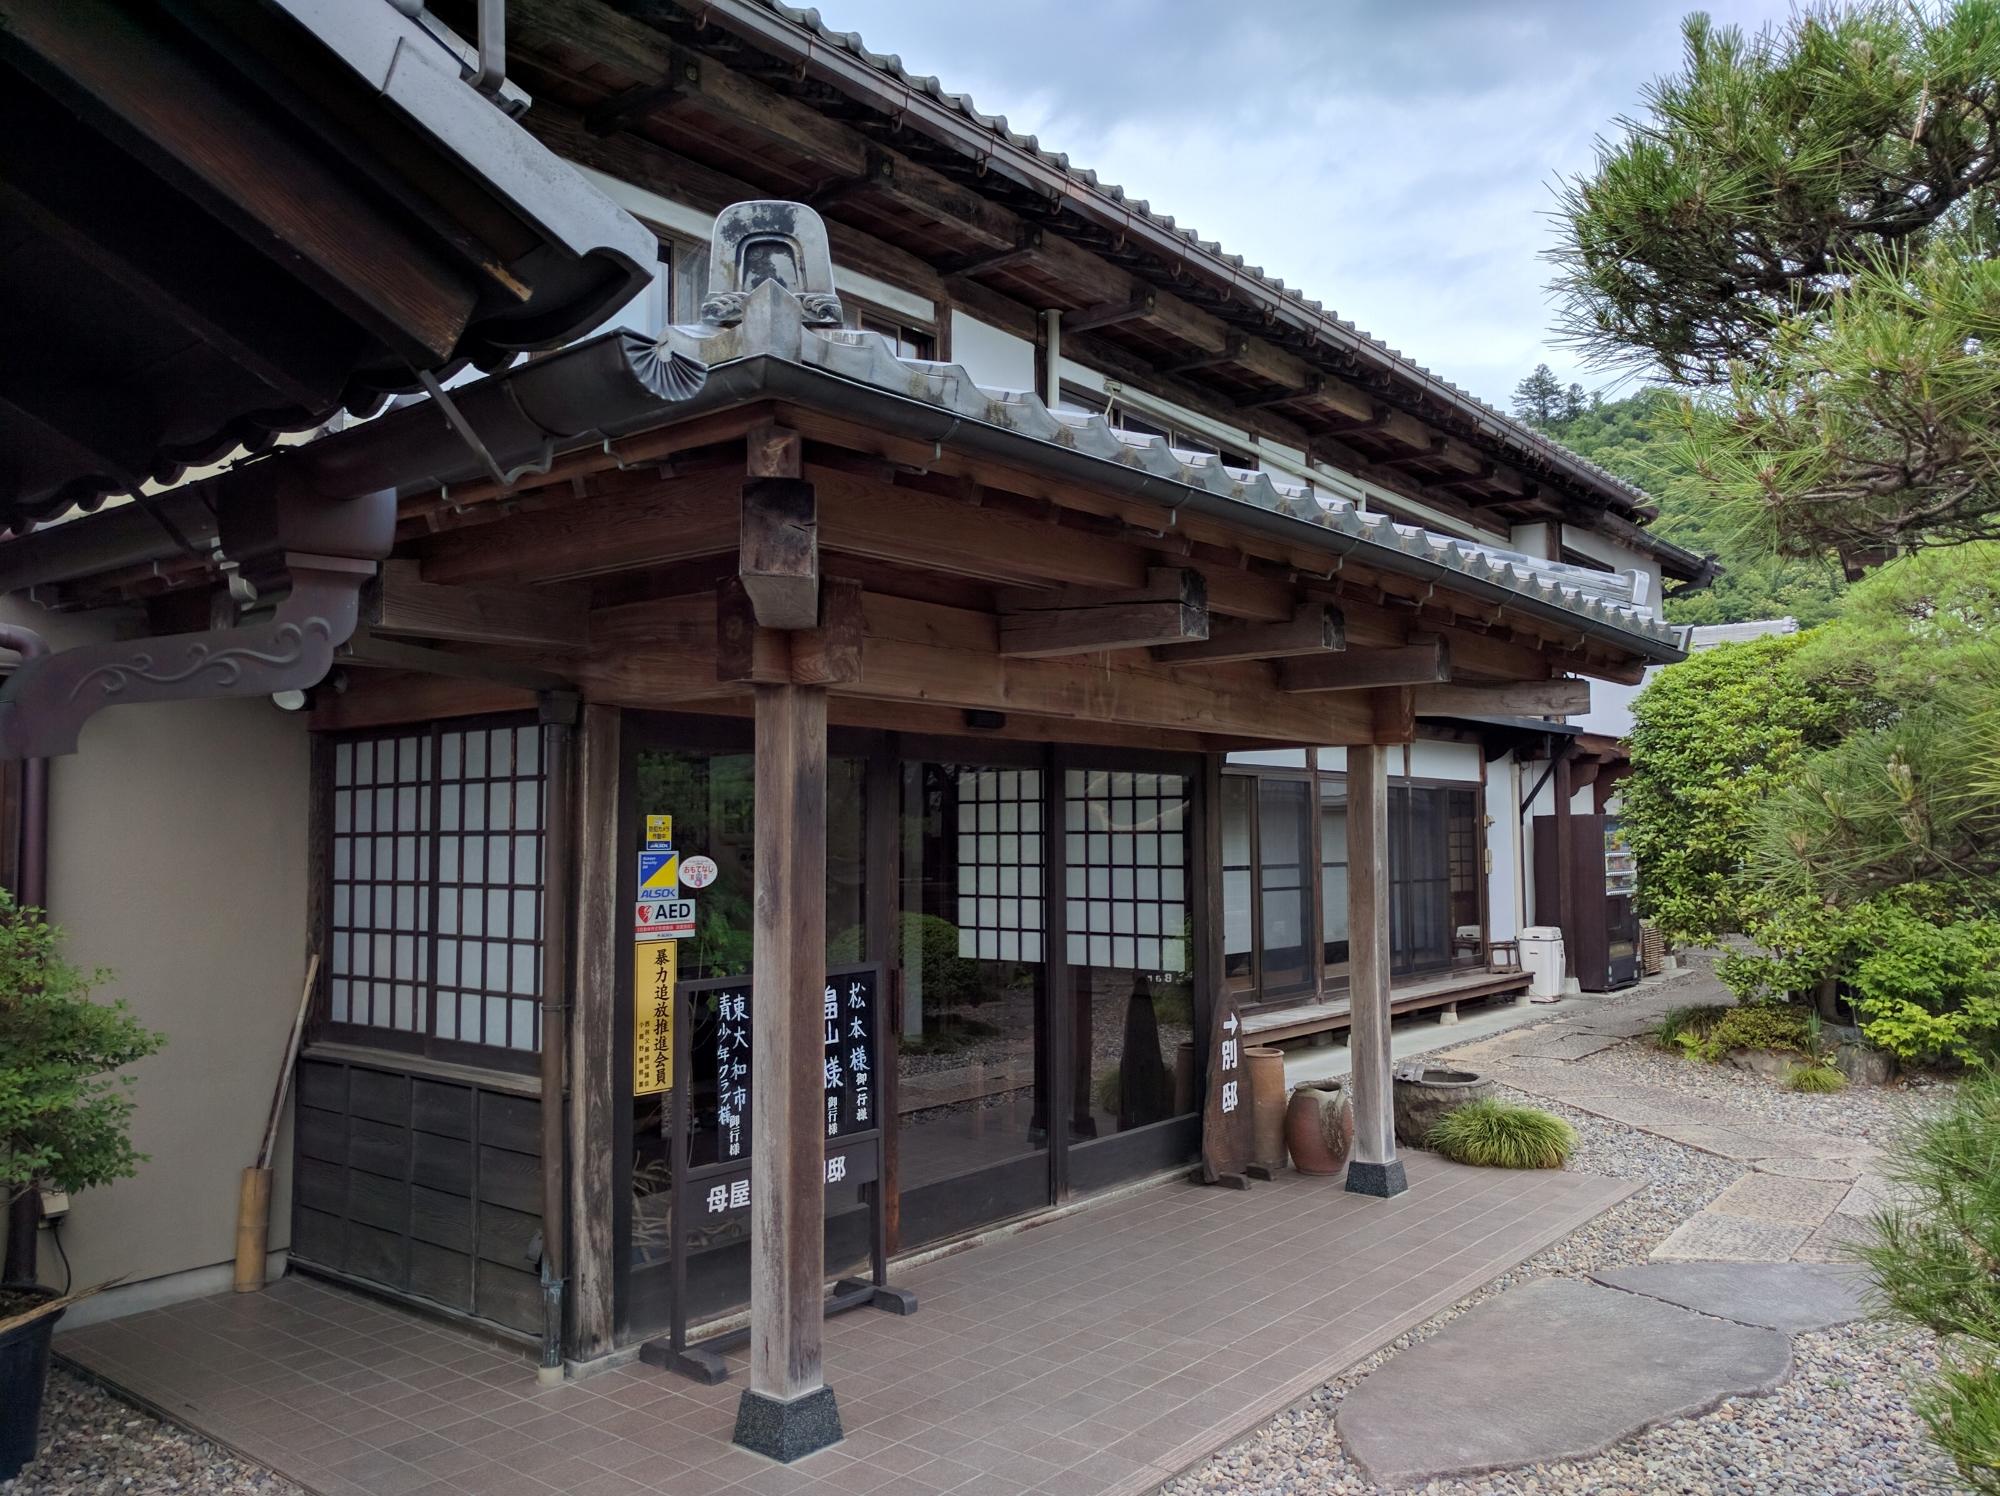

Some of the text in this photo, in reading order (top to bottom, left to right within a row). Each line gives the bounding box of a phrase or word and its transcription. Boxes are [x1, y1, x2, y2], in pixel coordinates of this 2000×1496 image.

[640, 889, 676, 899] ALSOK
[683, 865, 714, 875] おもてなし
[655, 903, 691, 920] AED
[654, 949, 670, 1086] 暴力追放推進会員
[731, 993, 750, 1112] 東大和市
[1221, 1038, 1239, 1114] 別邸
[706, 1155, 847, 1213] 母屋 邸
